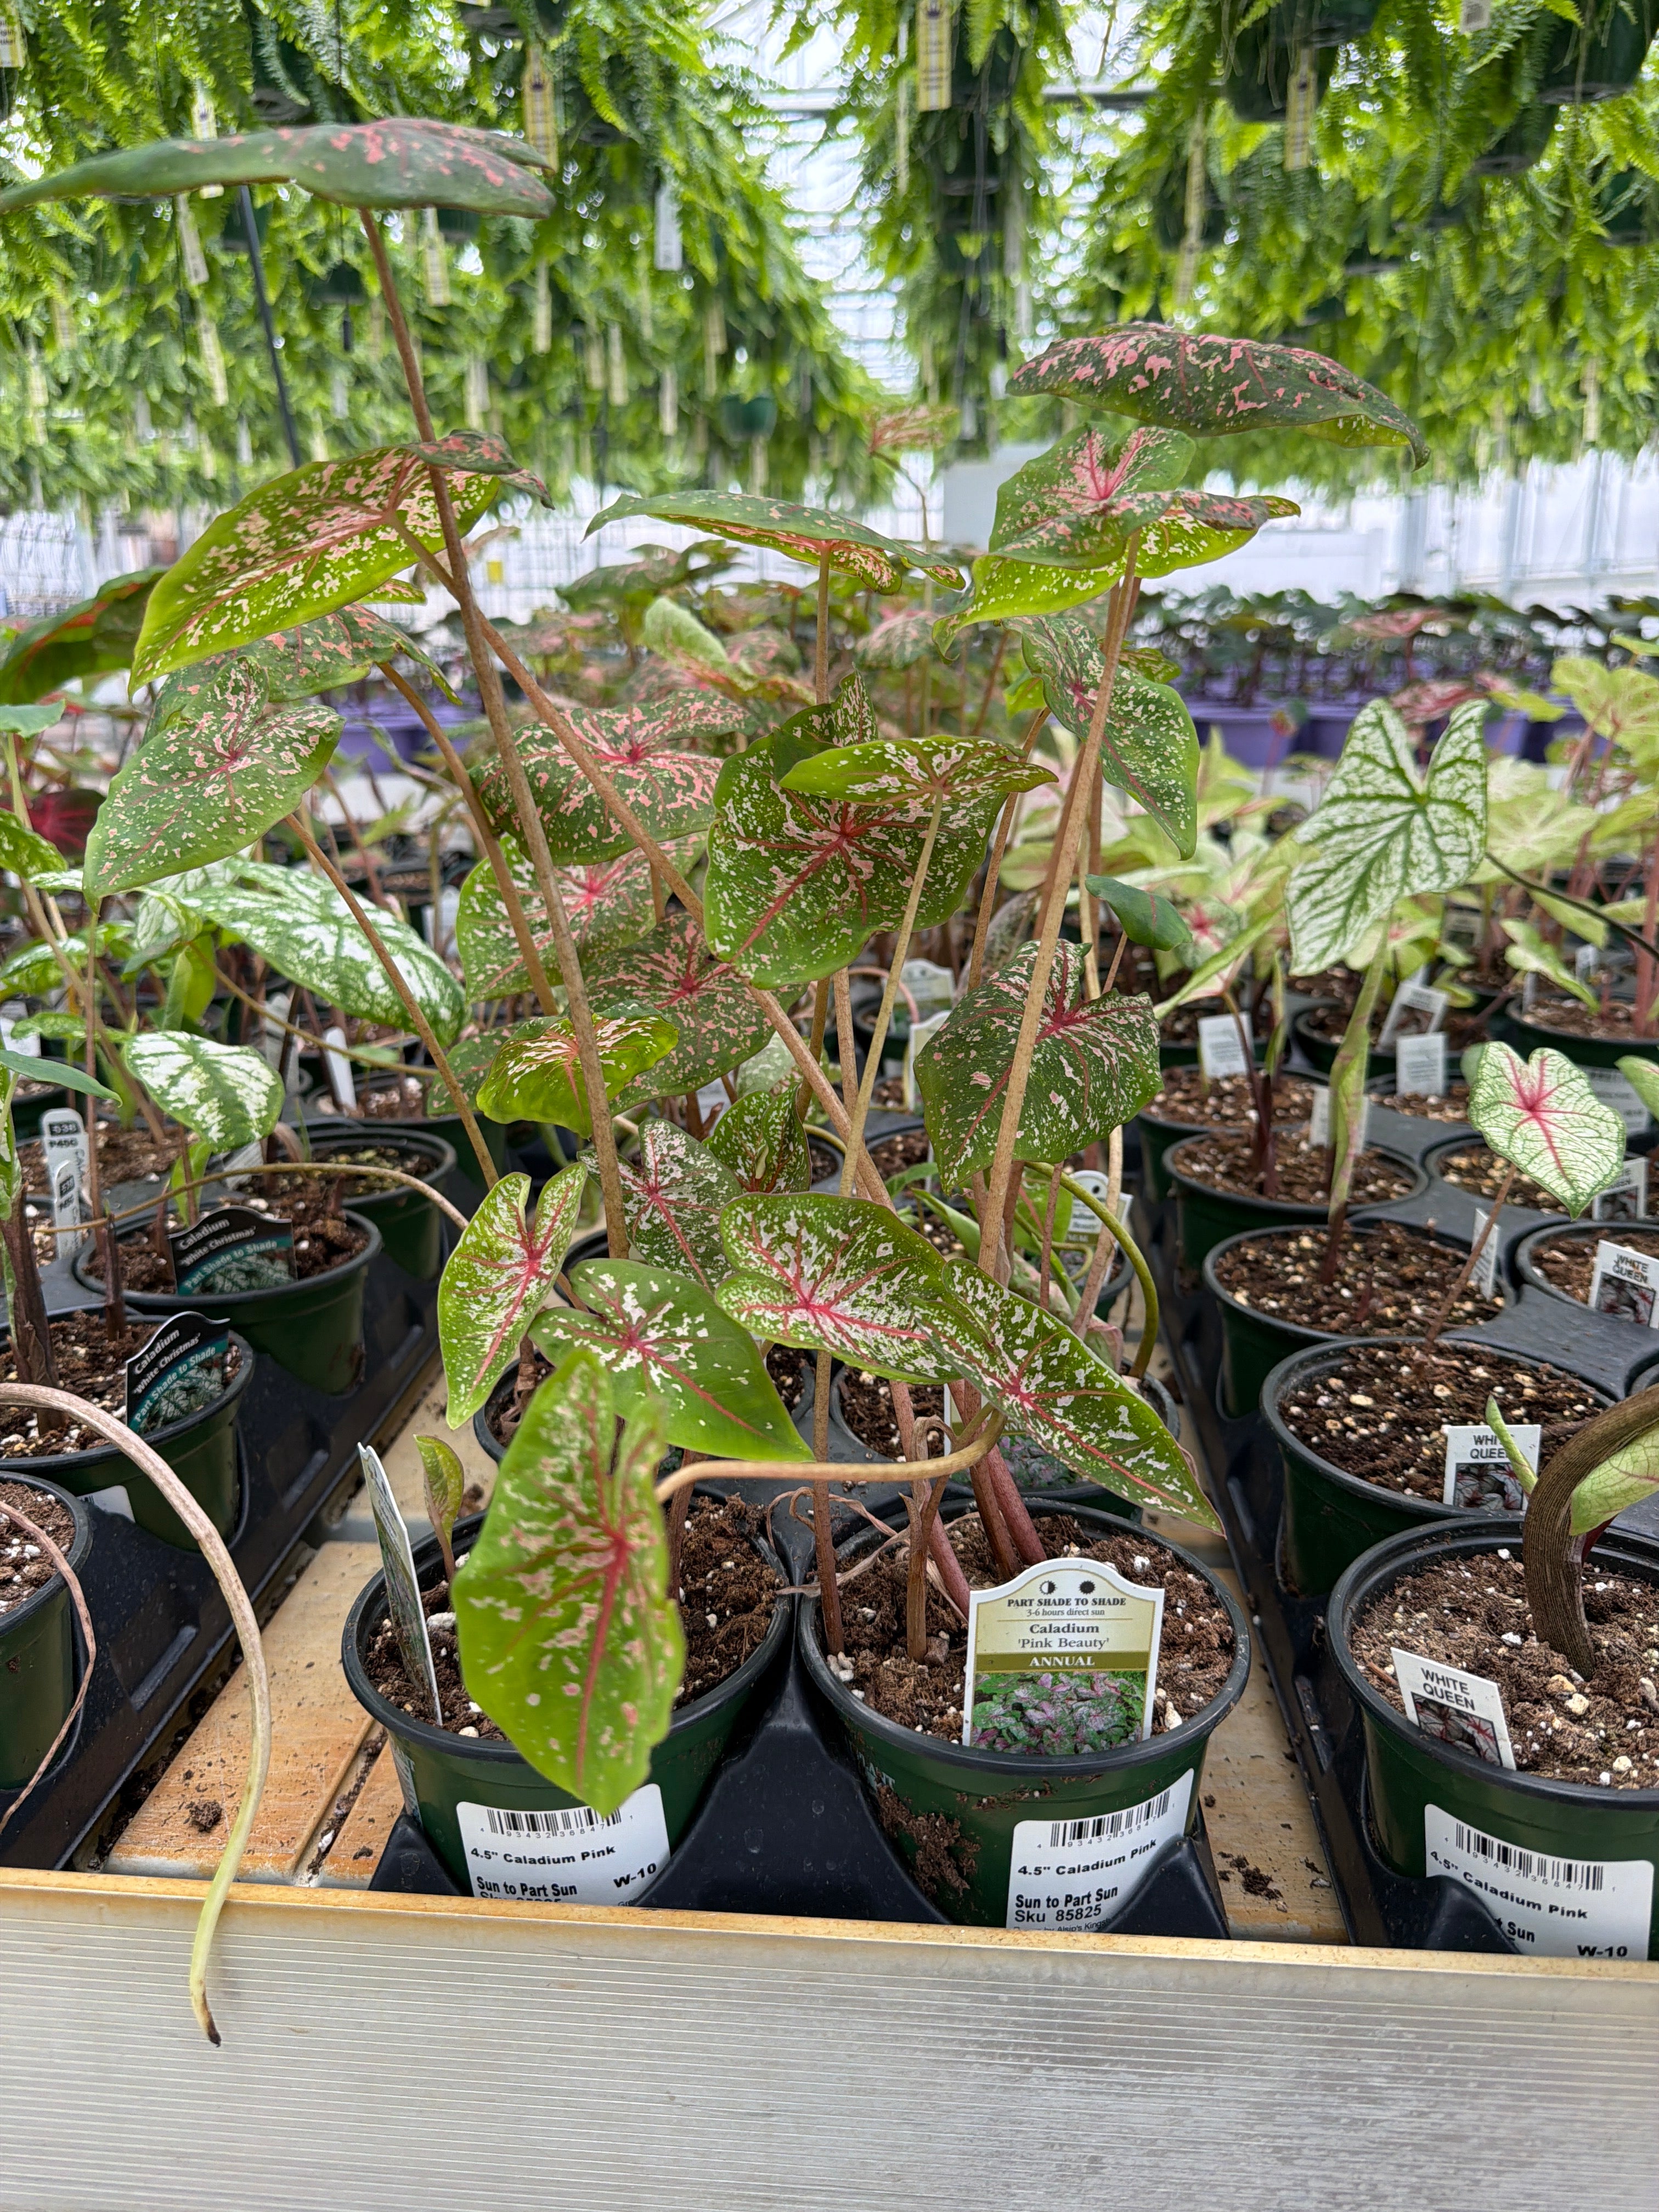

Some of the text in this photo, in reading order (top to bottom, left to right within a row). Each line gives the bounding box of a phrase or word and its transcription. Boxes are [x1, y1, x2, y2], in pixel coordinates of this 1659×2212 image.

[178, 1218, 230, 1250] Caladium
[183, 1240, 278, 1288] Part Shade to Shade
[1615, 1254, 1649, 1273] WHITE
[1612, 1265, 1648, 1283] QUEEN
[134, 1329, 180, 1374] Caladium
[135, 1347, 216, 1422] Part Shade to Shade
[1473, 1435, 1502, 1446] WHI
[1470, 1448, 1509, 1459] QUEE
[1007, 1599, 1034, 1607] PART
[1037, 1598, 1071, 1606] SHADE
[1092, 1598, 1127, 1606] SHADE
[1026, 1609, 1040, 1617] 3-6
[1042, 1608, 1064, 1616] hours
[1067, 1608, 1090, 1616] direct
[1030, 1623, 1100, 1634] Caladium
[1029, 1656, 1096, 1667] ANNUAL
[1421, 1667, 1470, 1695] WHITE
[1423, 1683, 1475, 1711] QUEEN
[1068, 1835, 1112, 1848] 93432
[471, 1846, 616, 1865] 4.5" Caladium Pink
[1018, 1839, 1157, 1876] 4.5" Caladium Pink
[613, 1863, 657, 1888] W-10
[1430, 1850, 1588, 1919] 4.5" Caladium Pink
[477, 1876, 500, 1893] Sun
[503, 1881, 516, 1894] to
[520, 1882, 549, 1897] Part
[551, 1883, 577, 1897] Sun
[1015, 1887, 1119, 1909] Sun to Part Sun
[1014, 1904, 1102, 1922] Sku 85825
[1508, 1921, 1534, 1943] Sun
[1577, 1945, 1627, 1957] W-10
